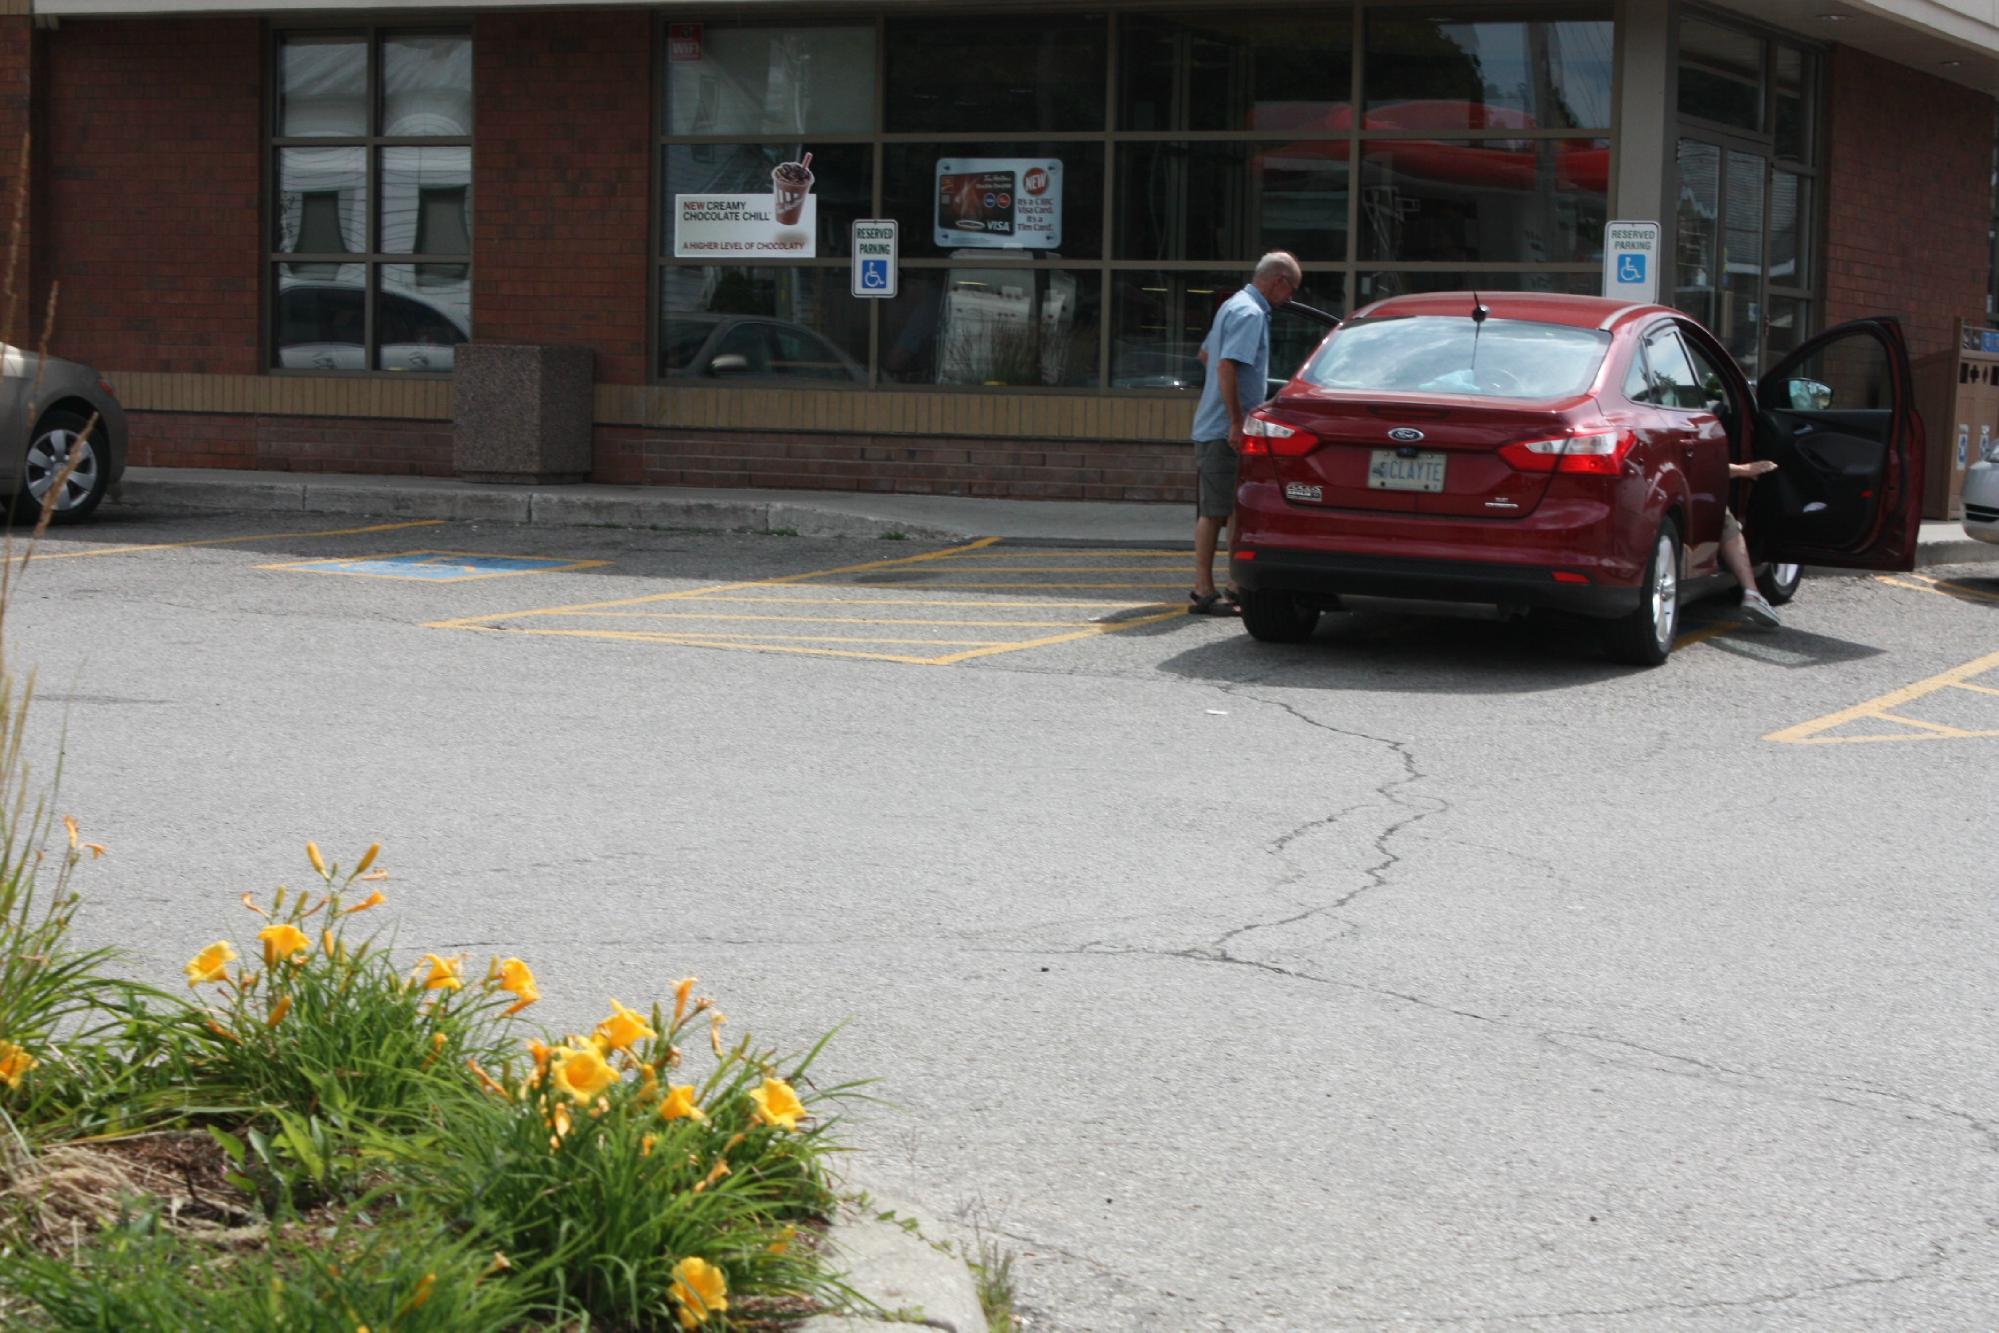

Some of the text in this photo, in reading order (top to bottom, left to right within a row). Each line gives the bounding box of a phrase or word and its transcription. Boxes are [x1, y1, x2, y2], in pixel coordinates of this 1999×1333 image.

[1025, 174, 1046, 191] NEW
[683, 201, 746, 211] NEW CREAMY
[683, 211, 770, 221] CHOCOLATE CHILL
[986, 220, 1010, 232] VISA
[856, 227, 894, 240] RESERVED
[1611, 230, 1656, 240] RESERVED
[689, 242, 719, 250] HIGHER
[720, 242, 743, 250] LEVEL
[744, 242, 754, 250] OF
[756, 242, 804, 250] CHOCOLATY
[859, 243, 891, 255] PARKING
[1614, 241, 1652, 250] PARKING
